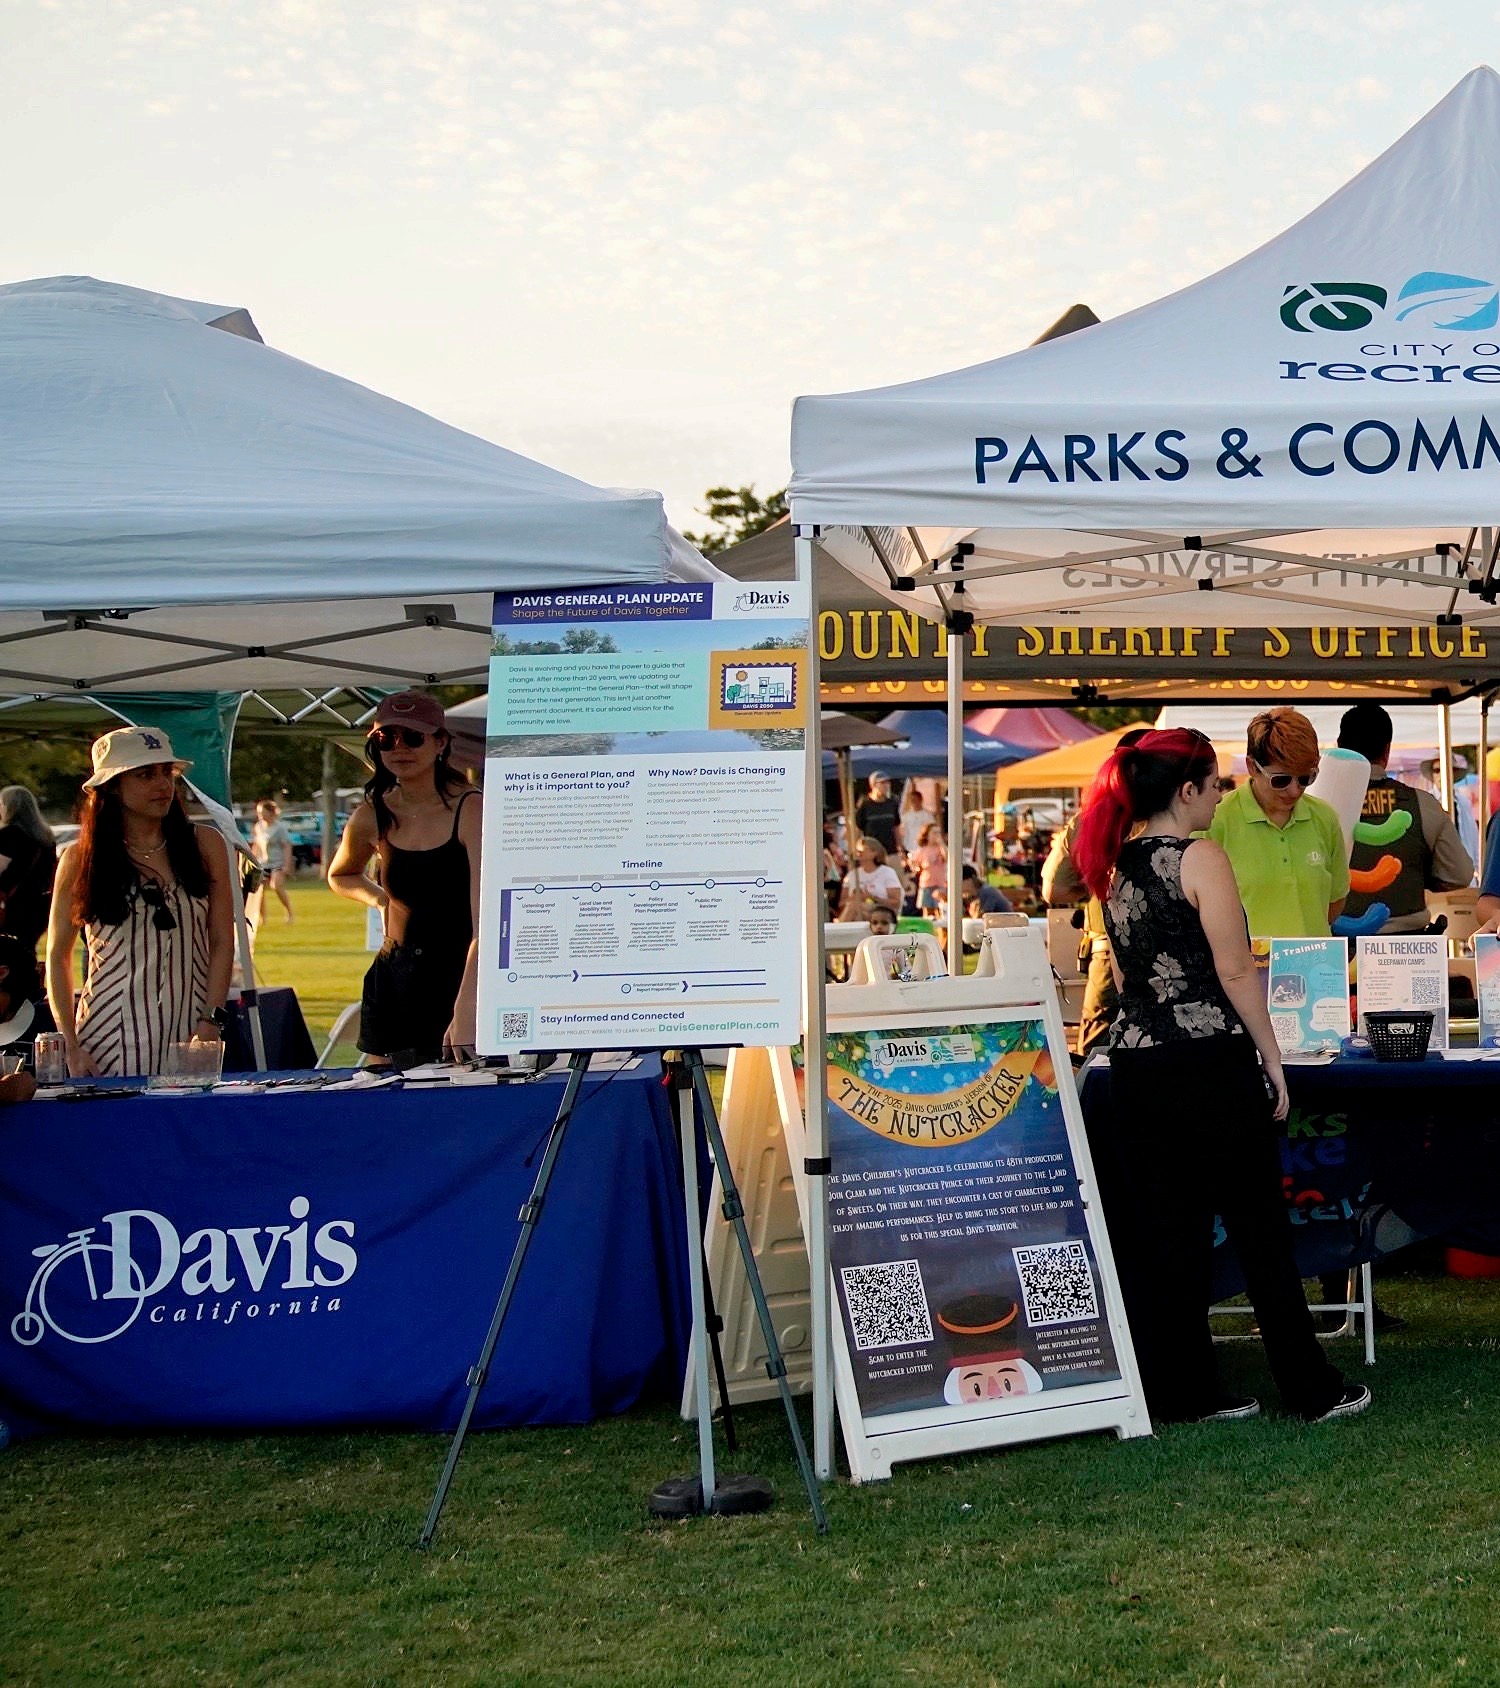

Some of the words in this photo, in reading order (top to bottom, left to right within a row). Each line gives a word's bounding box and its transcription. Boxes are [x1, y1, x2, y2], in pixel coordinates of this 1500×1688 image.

[1359, 343, 1454, 356] CITY
[975, 429, 1190, 484] PARKS
[1216, 427, 1264, 480] &
[513, 596, 552, 607] DAVIS
[555, 594, 613, 606] GENERAL
[616, 593, 650, 604] PLAN
[654, 592, 703, 604] UPDATE
[750, 590, 790, 604] Davis
[512, 609, 545, 620] Shape
[548, 608, 563, 617] the
[567, 608, 598, 617] Future
[601, 607, 611, 615] of
[613, 606, 641, 615] Davis
[645, 605, 689, 616] Together
[818, 609, 990, 661] OUNTY
[1310, 626, 1488, 660] OFFICE
[505, 771, 531, 781] What
[532, 771, 541, 780] is
[550, 770, 589, 780] General
[590, 770, 614, 780] Plan,
[616, 769, 635, 778] and
[648, 768, 670, 779] Why
[672, 767, 698, 777] Now?
[700, 766, 727, 776] Davis
[728, 766, 737, 775] is
[738, 765, 786, 776] Changing
[504, 783, 525, 793] why
[526, 782, 534, 791] is
[536, 782, 543, 791] it
[545, 781, 594, 792] important
[595, 781, 606, 789] to
[607, 780, 631, 791] you?
[622, 859, 663, 869] Timeline
[1282, 941, 1328, 957] Training
[1364, 942, 1387, 955] FALL
[1389, 941, 1438, 955] TREKKERS
[1377, 958, 1408, 966] SLEEPAWAY
[1408, 958, 1426, 966] CAMPS
[541, 1014, 563, 1025] Stay
[564, 1013, 609, 1023] Informed
[610, 1012, 630, 1021] and
[632, 1011, 685, 1021] Connected
[658, 1021, 780, 1032] DavisGeneralPlan.com
[887, 1040, 927, 1058] Davis
[884, 1095, 903, 1109] 2025
[887, 1068, 1025, 1140] NUTCRACKER
[102, 1196, 358, 1299] Davis
[149, 1297, 342, 1324] California
